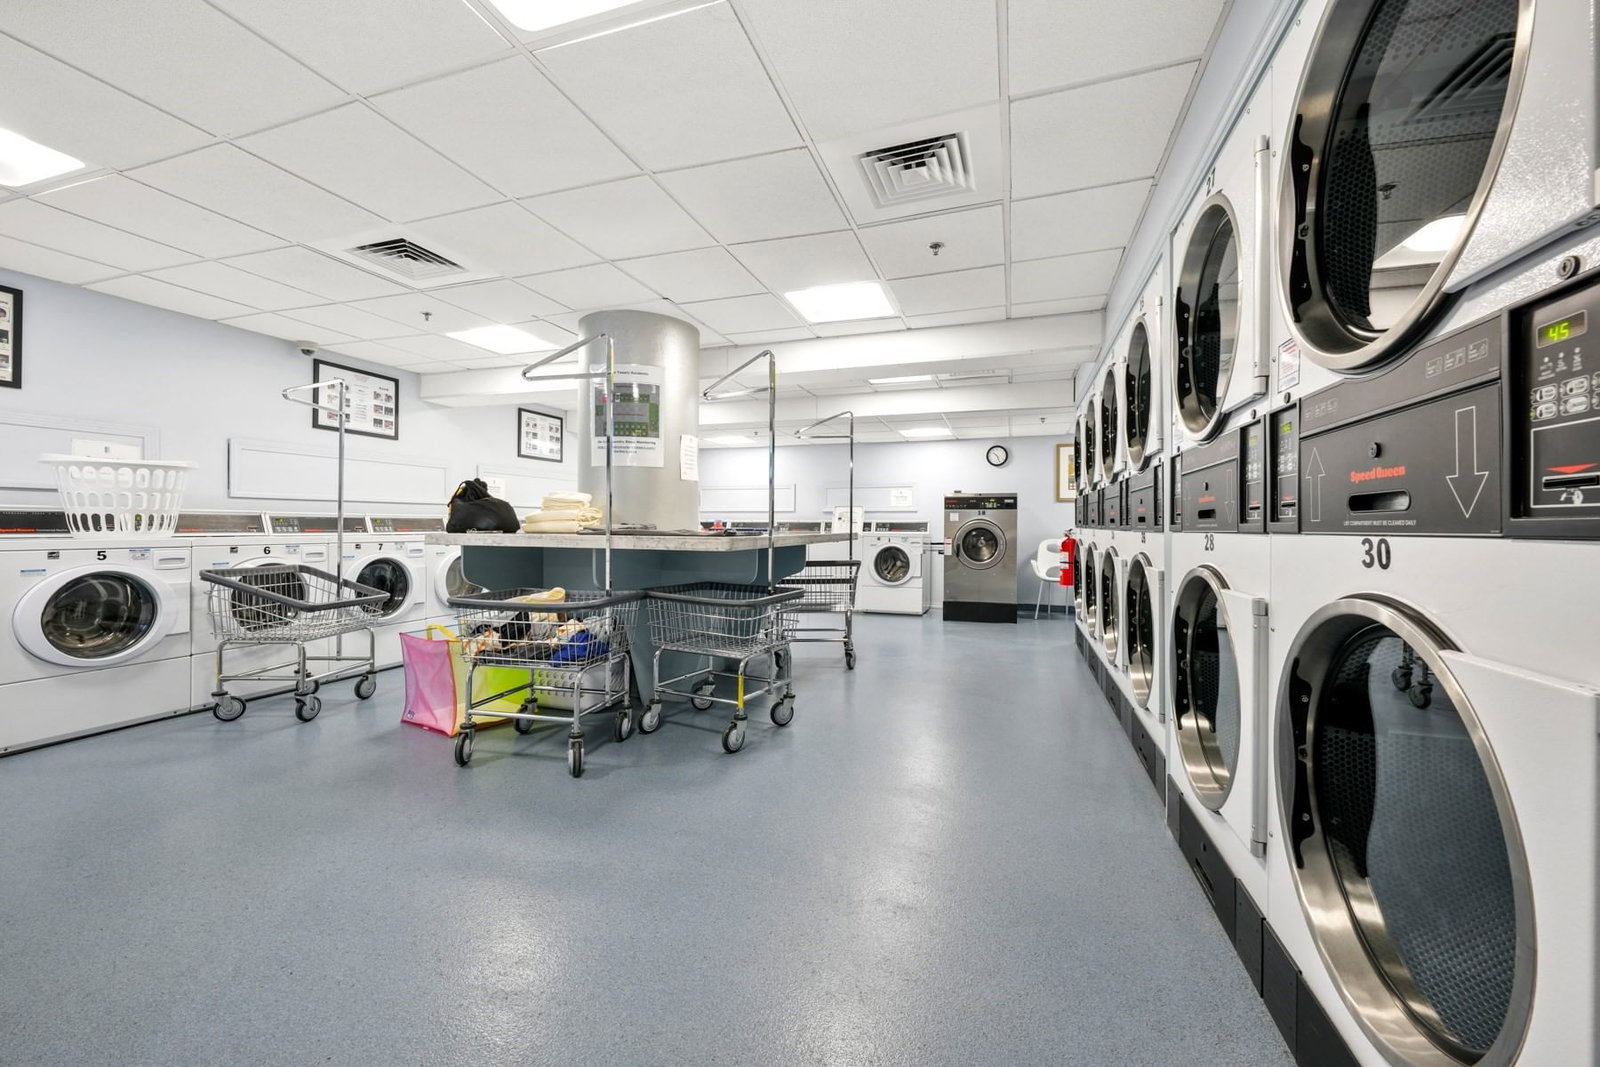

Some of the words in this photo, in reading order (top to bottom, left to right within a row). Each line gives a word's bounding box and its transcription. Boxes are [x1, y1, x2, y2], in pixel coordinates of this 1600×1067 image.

[1206, 167, 1216, 196] 27
[1549, 323, 1569, 341] 45
[1350, 468, 1376, 484] Speed
[1376, 466, 1406, 478] Queen
[263, 546, 271, 555] 6
[378, 543, 384, 551] 7
[1204, 534, 1214, 551] 28
[97, 550, 107, 561] 5
[1361, 537, 1391, 570] 30
